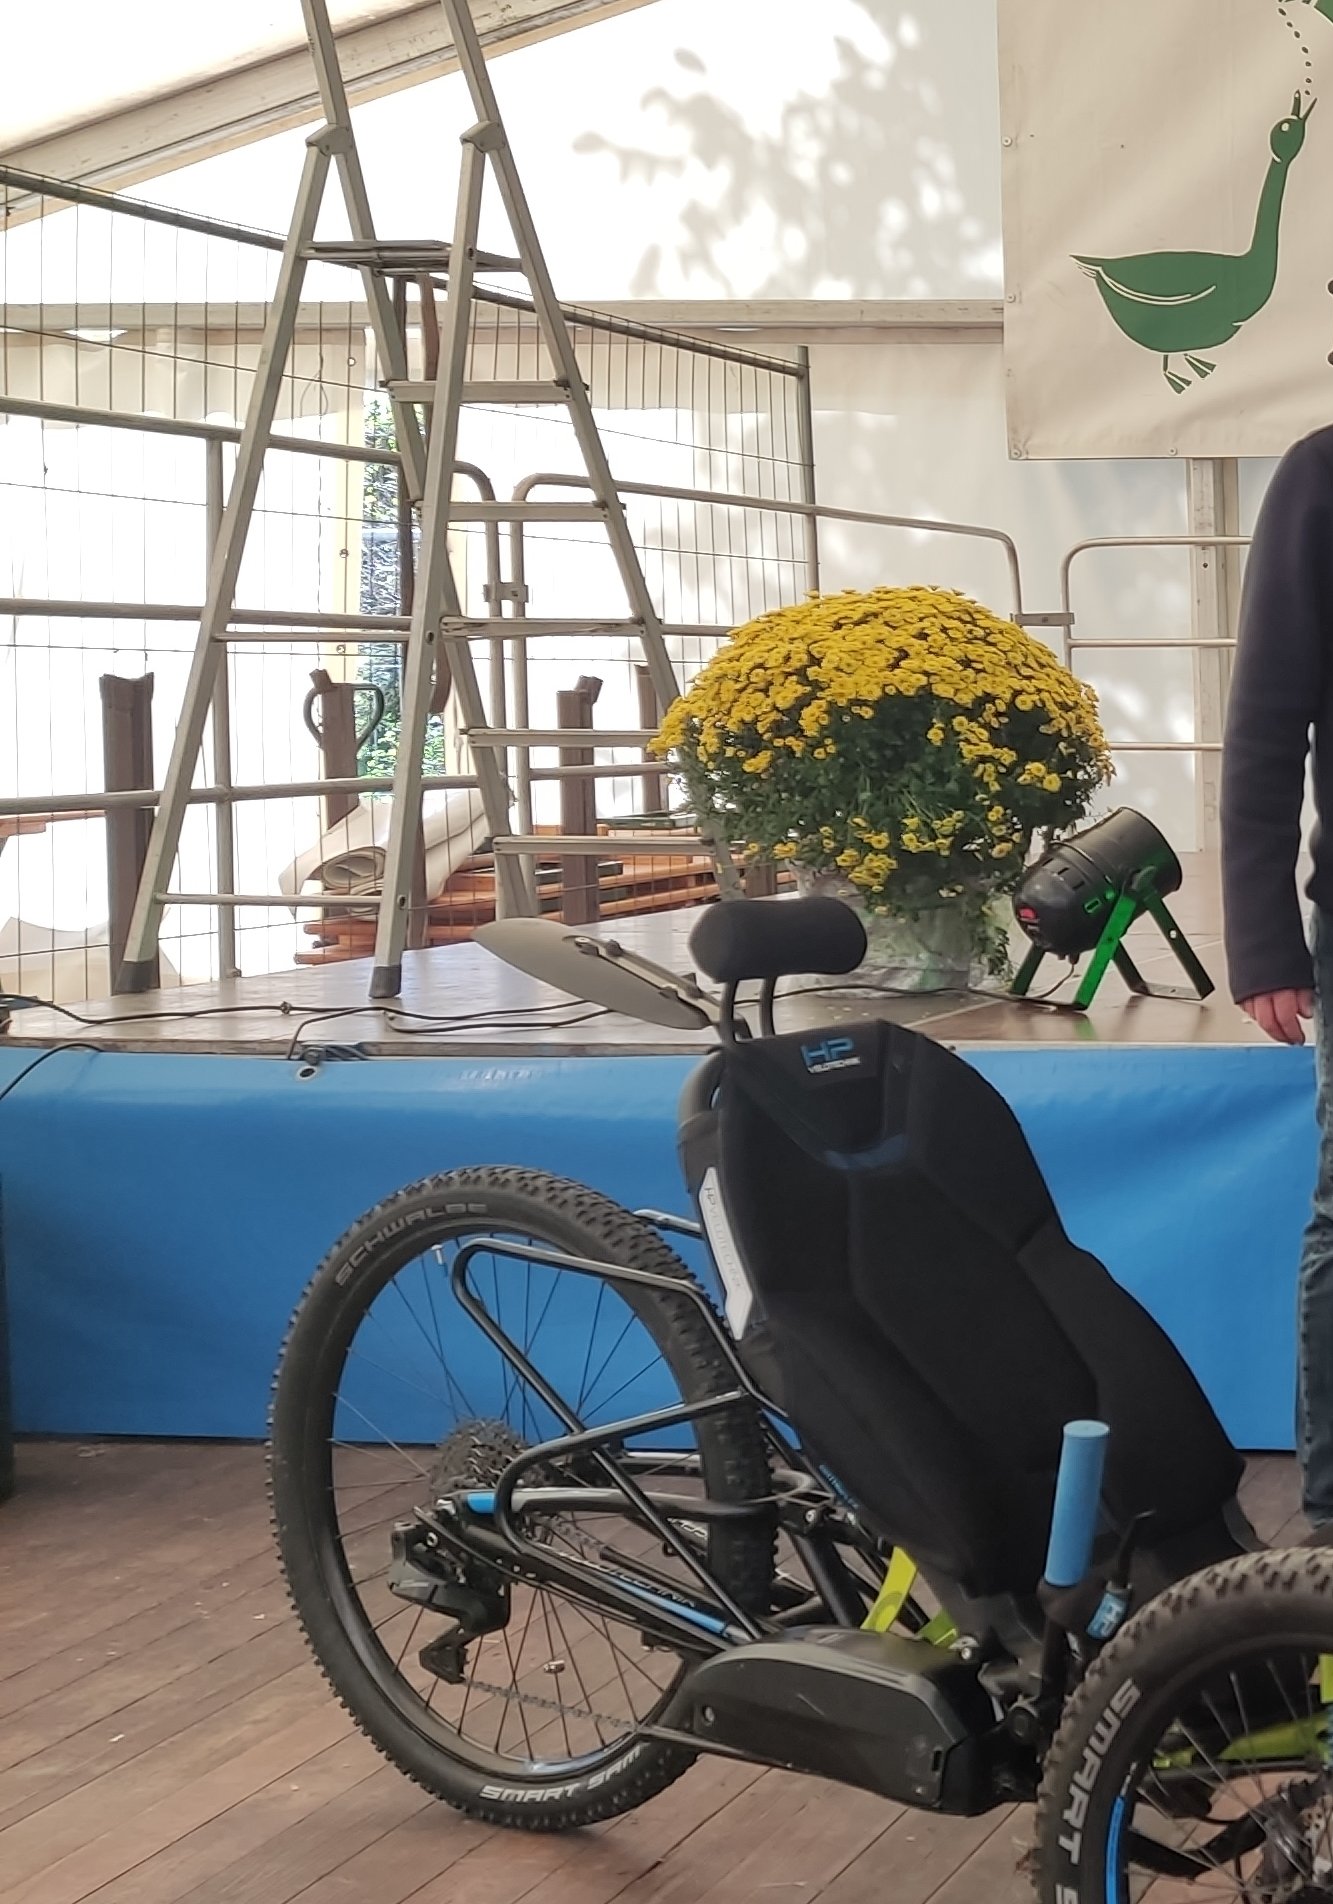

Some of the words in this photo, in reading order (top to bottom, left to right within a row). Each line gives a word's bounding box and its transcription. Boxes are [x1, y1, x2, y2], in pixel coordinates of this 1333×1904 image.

[801, 1038, 855, 1070] HP
[335, 1202, 488, 1286] SCHWALBE
[479, 1783, 581, 1803] SMART
[587, 1742, 651, 1791] SAM
[1058, 1680, 1141, 1865] SMART
